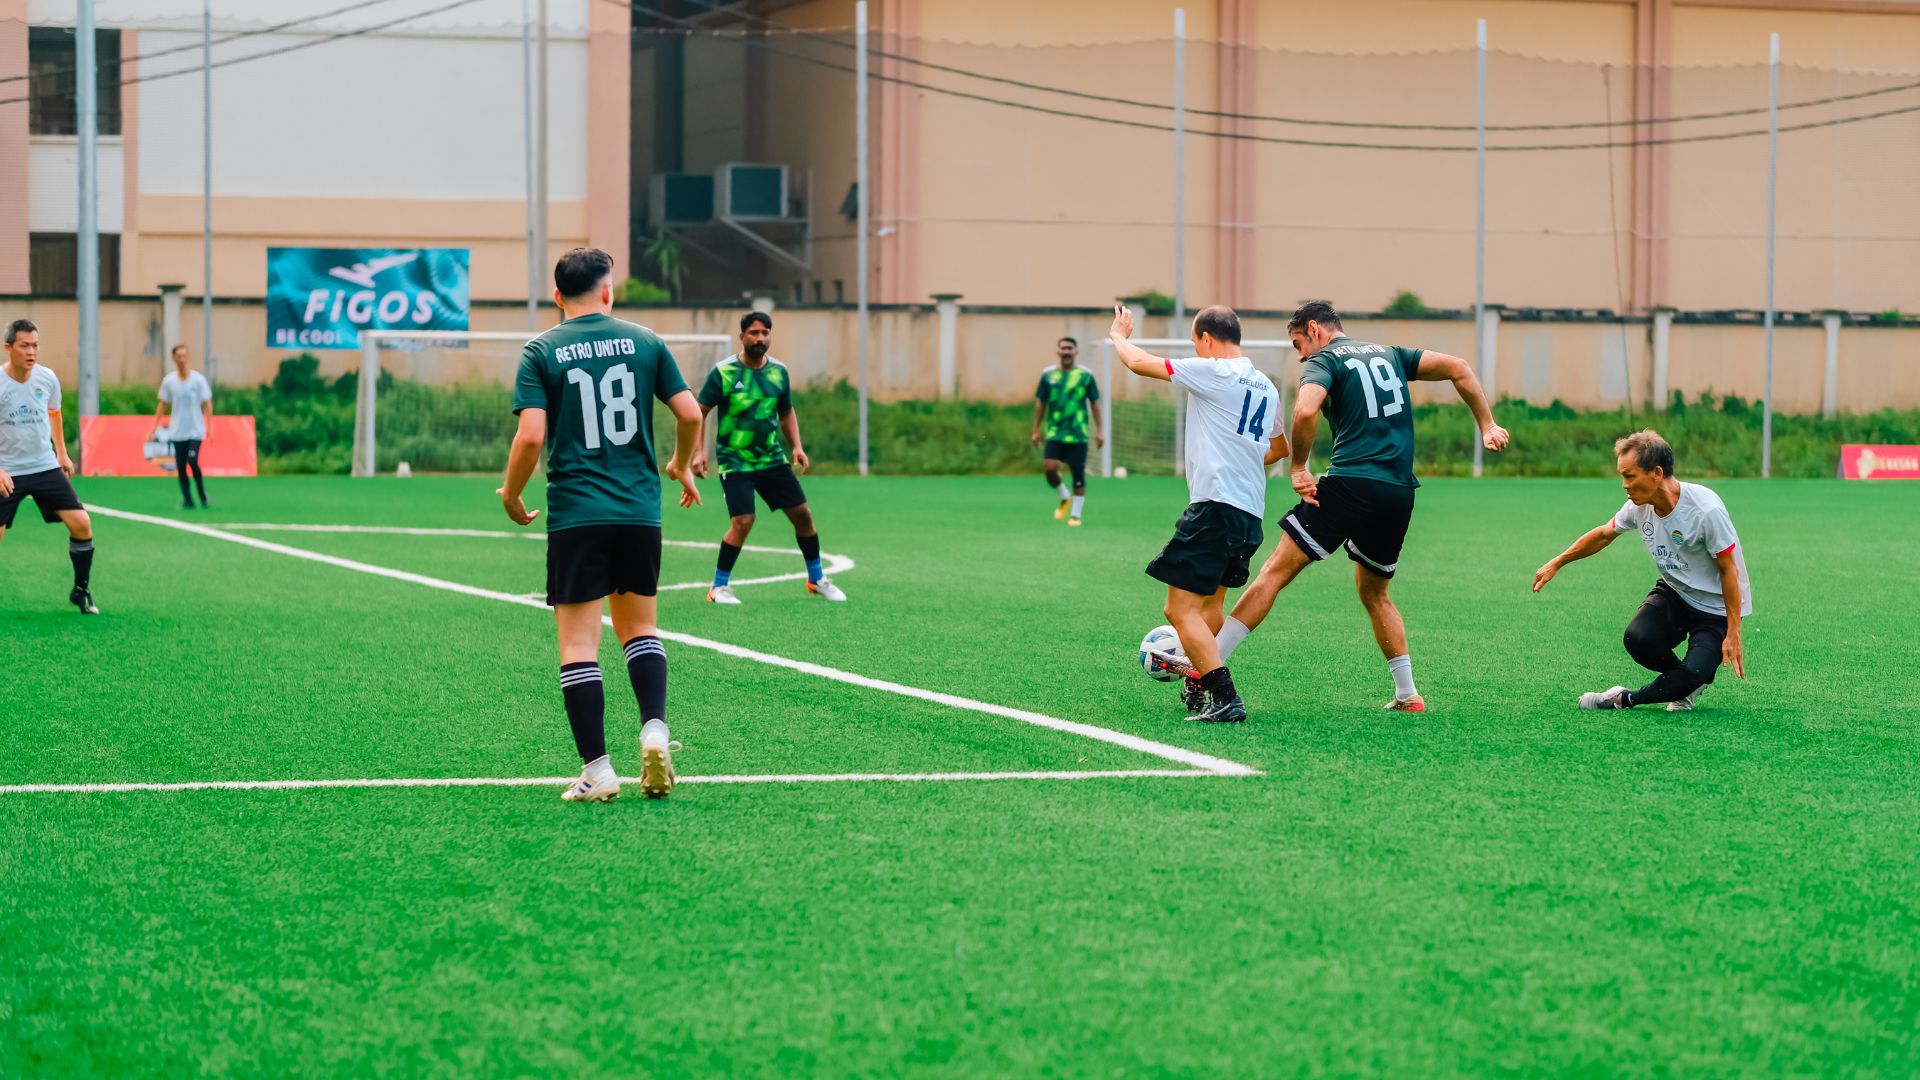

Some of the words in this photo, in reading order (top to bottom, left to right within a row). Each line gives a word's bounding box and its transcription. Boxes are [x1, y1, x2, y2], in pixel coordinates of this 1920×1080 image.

[276, 328, 296, 344] BE
[555, 342, 593, 363] RETRO
[593, 338, 636, 357] UNITED
[567, 363, 638, 449] 18
[1344, 356, 1405, 419] 19
[1236, 389, 1268, 442] 14
